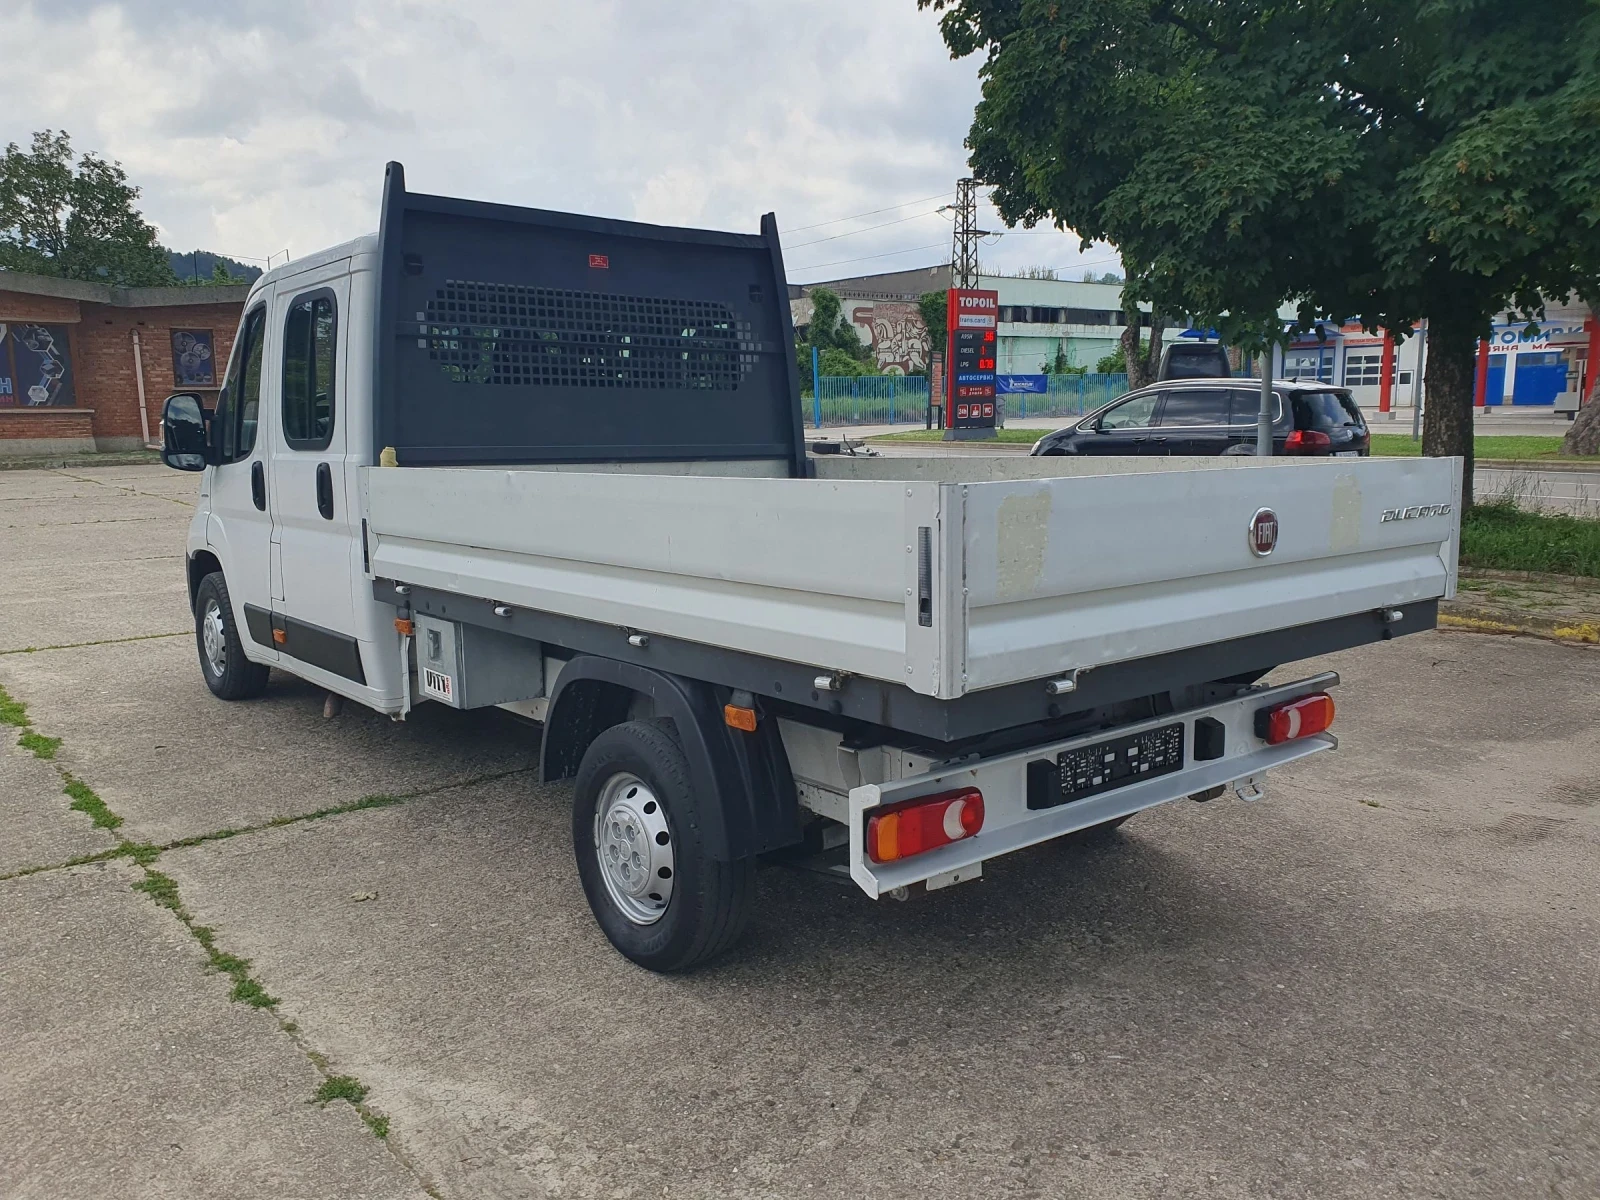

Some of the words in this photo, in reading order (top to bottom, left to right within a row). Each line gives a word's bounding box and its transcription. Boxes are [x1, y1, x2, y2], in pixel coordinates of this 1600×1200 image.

[959, 296, 995, 308] TOPOIL
[1380, 504, 1451, 523] DUCATO
[1258, 521, 1274, 544] FIAT
